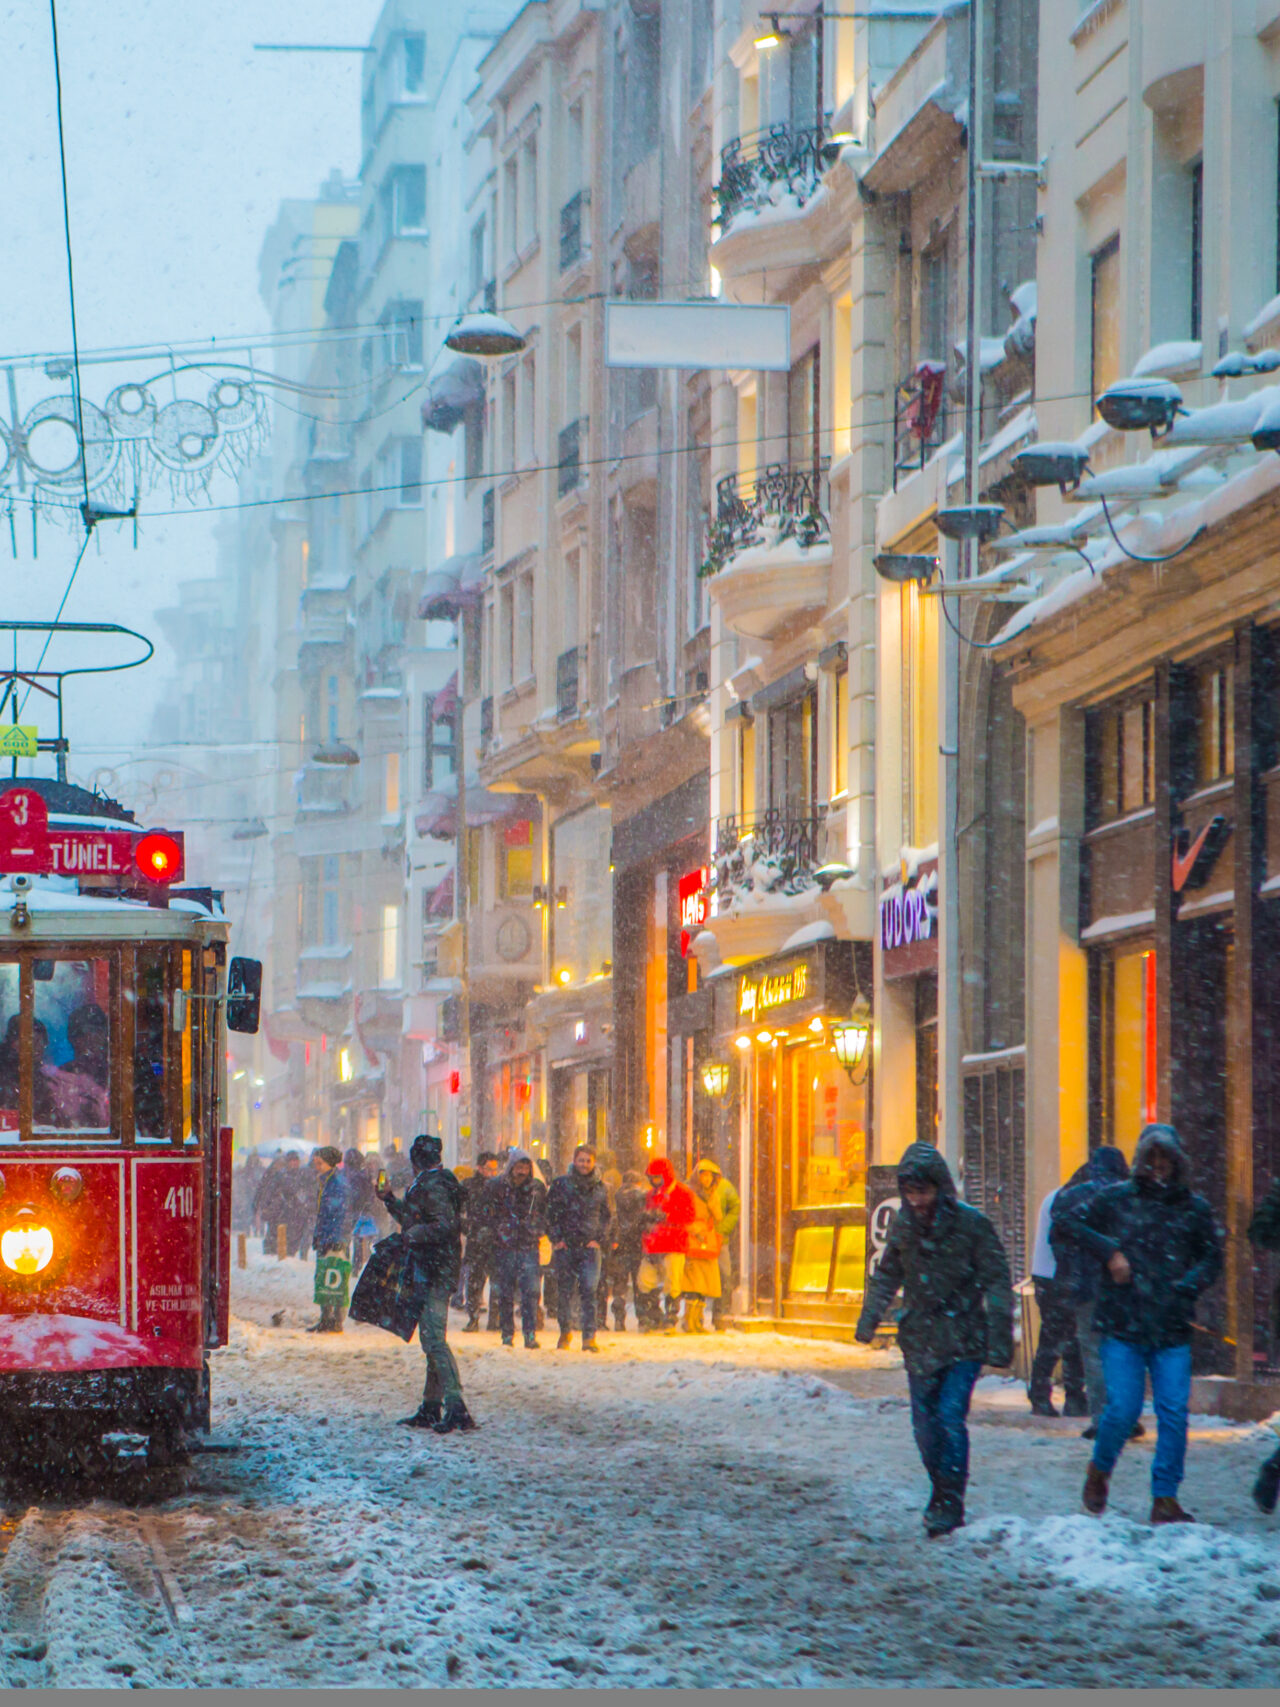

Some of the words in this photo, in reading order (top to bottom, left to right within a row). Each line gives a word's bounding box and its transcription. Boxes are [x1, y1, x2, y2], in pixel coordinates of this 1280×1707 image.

[11, 795, 29, 825] 3
[49, 839, 120, 870] TÜNEL
[163, 1186, 194, 1218] 410
[324, 1267, 343, 1289] D
